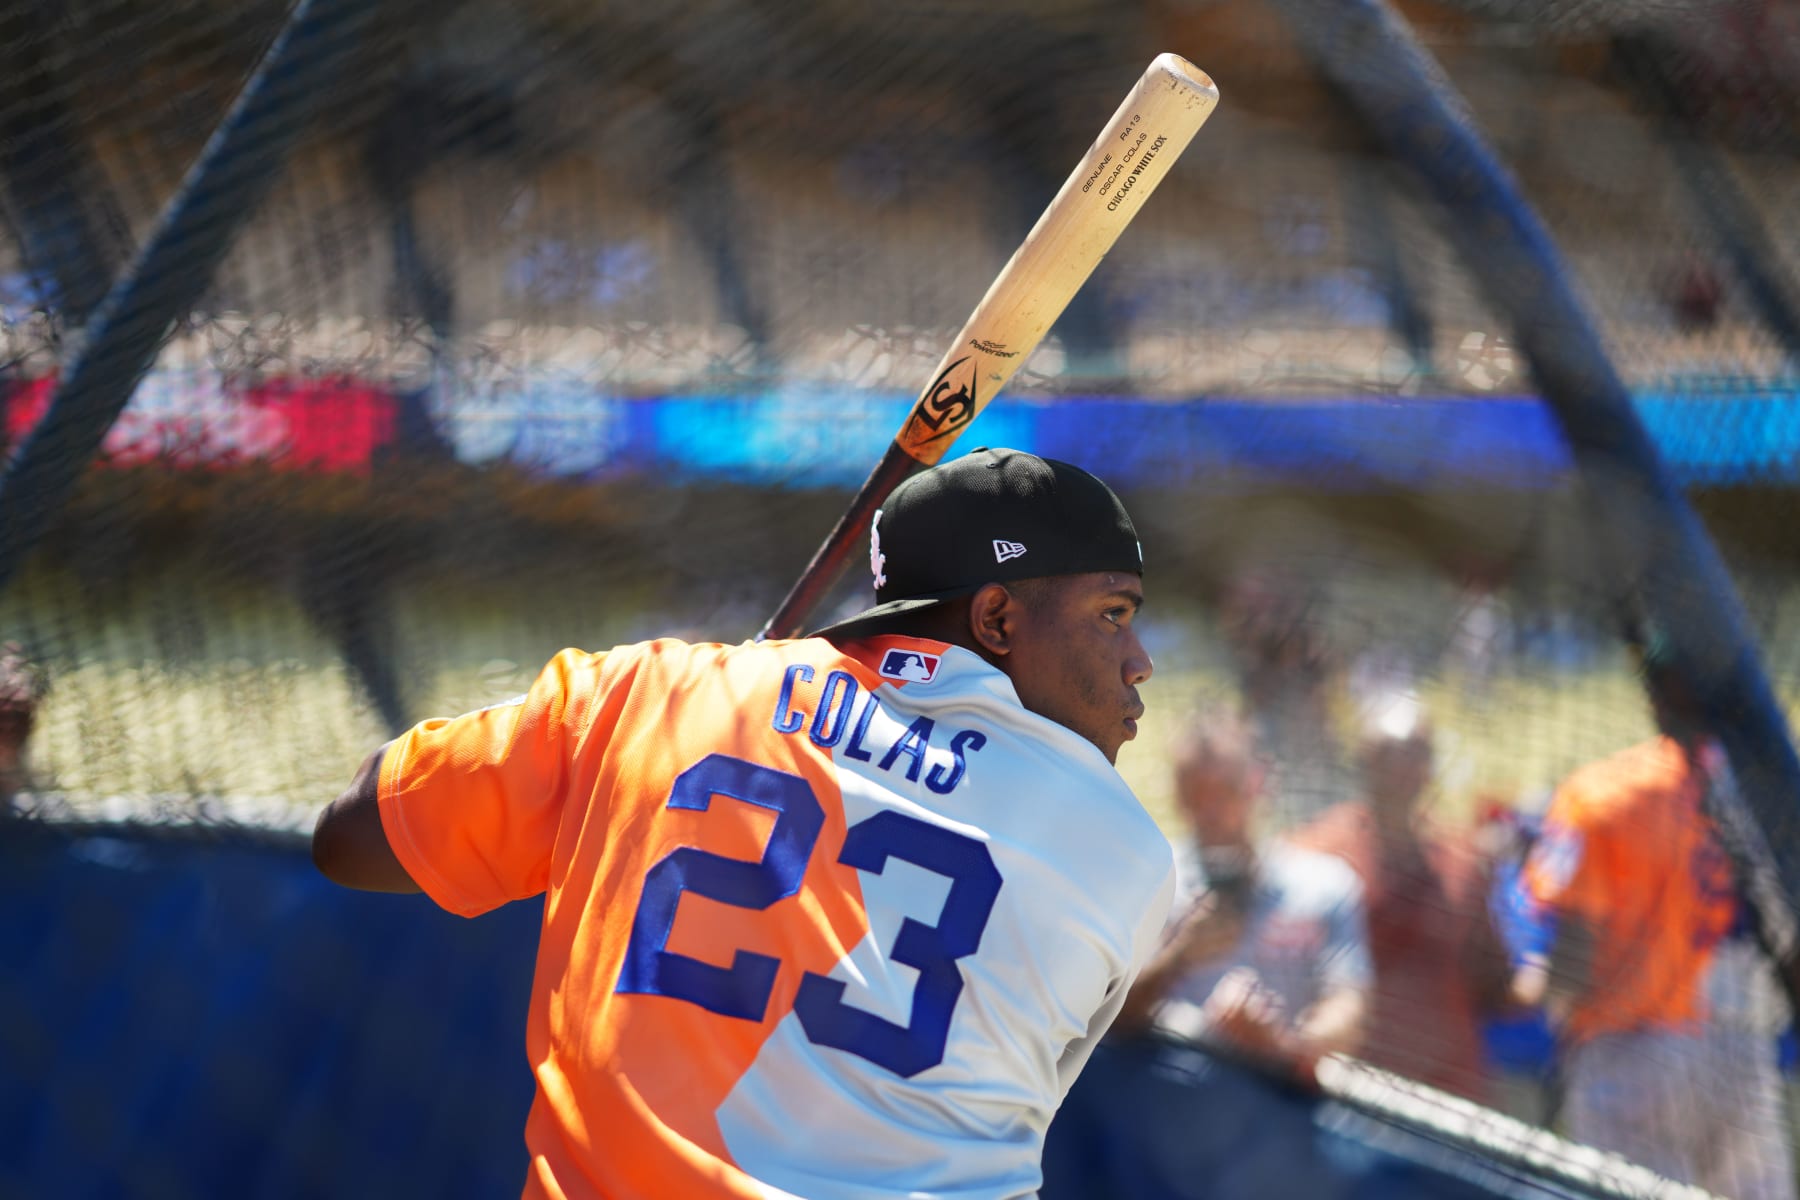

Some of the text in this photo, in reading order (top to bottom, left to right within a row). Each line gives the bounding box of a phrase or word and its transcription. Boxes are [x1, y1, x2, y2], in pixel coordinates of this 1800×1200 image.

[1082, 114, 1141, 193] GENUINE RA13
[1098, 132, 1148, 196] OSCAR COLAS
[1107, 135, 1168, 212] CHICAGO WHITE SOX
[772, 664, 988, 795] COLAS
[614, 752, 1004, 1079] 23
